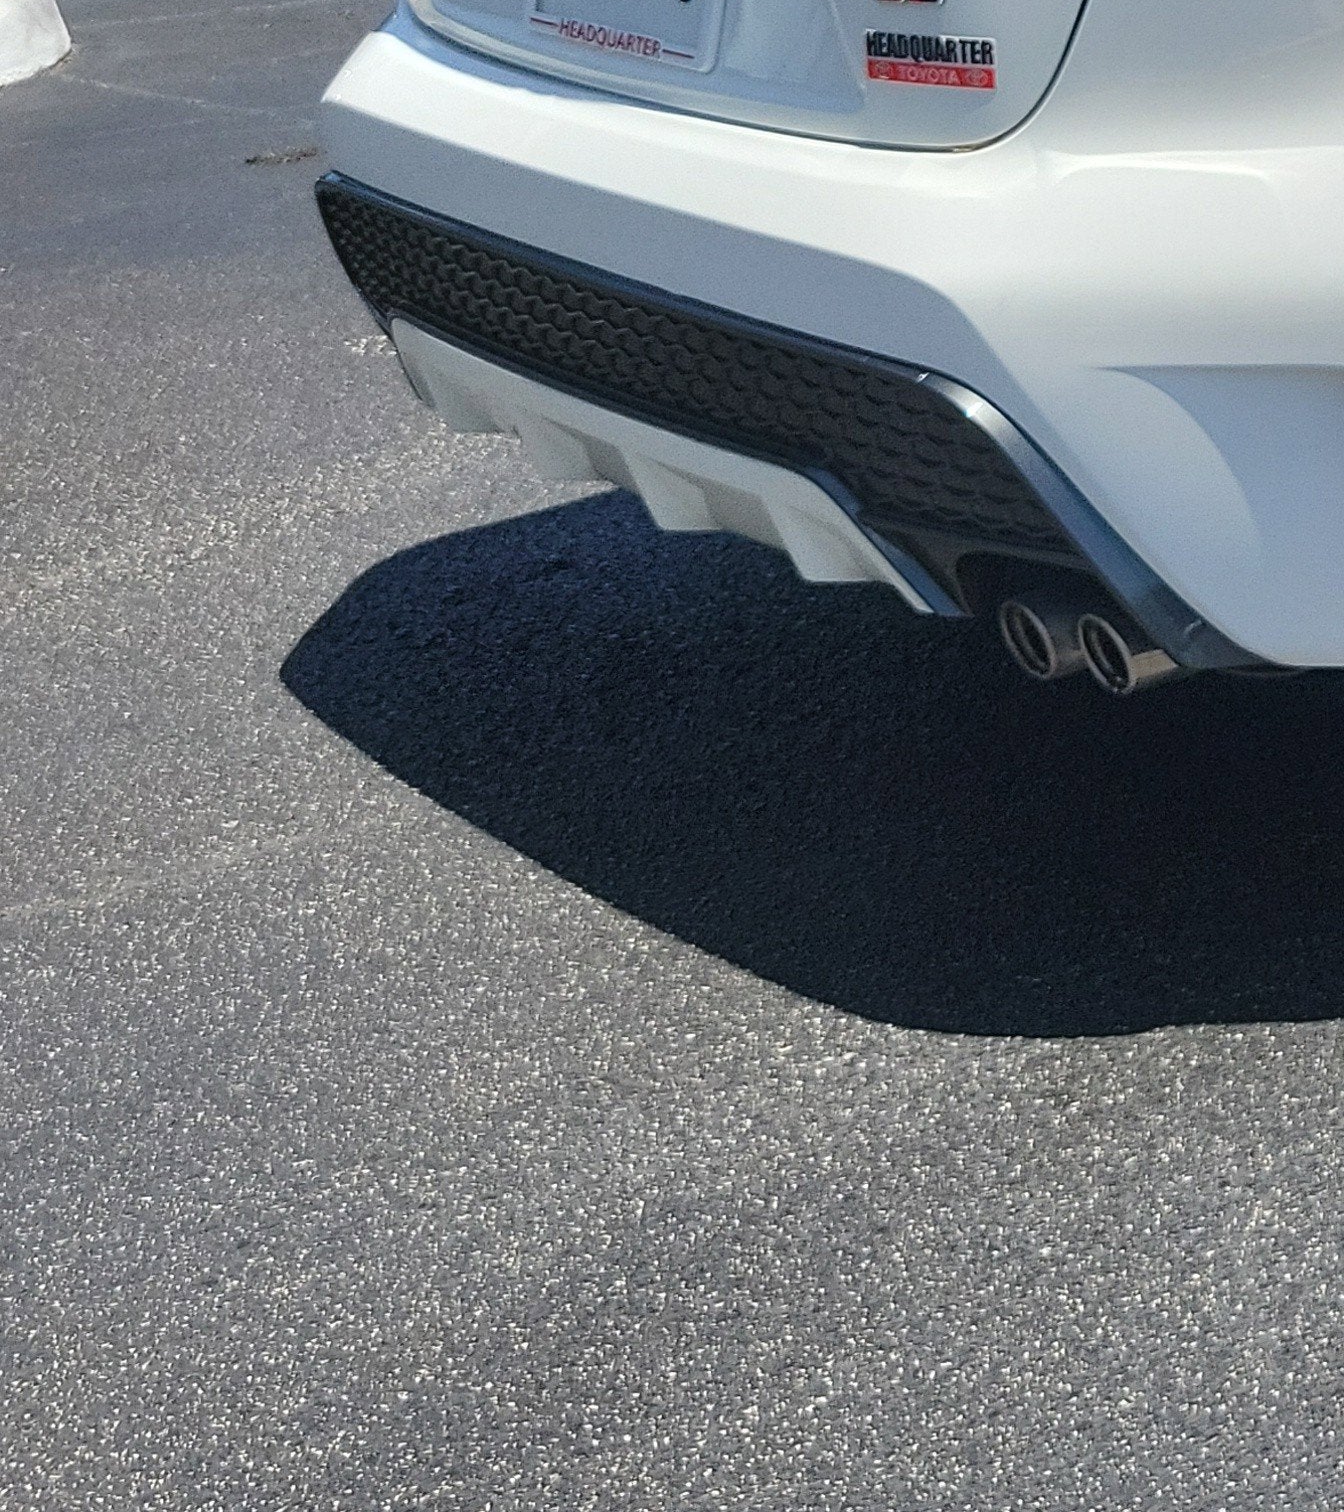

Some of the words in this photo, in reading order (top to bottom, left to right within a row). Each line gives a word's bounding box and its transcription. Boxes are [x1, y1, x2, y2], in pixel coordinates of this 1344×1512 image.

[559, 18, 663, 59] HEADQUARTER
[866, 30, 994, 65] HEADQUARTER
[899, 66, 962, 84] TOYOTA
